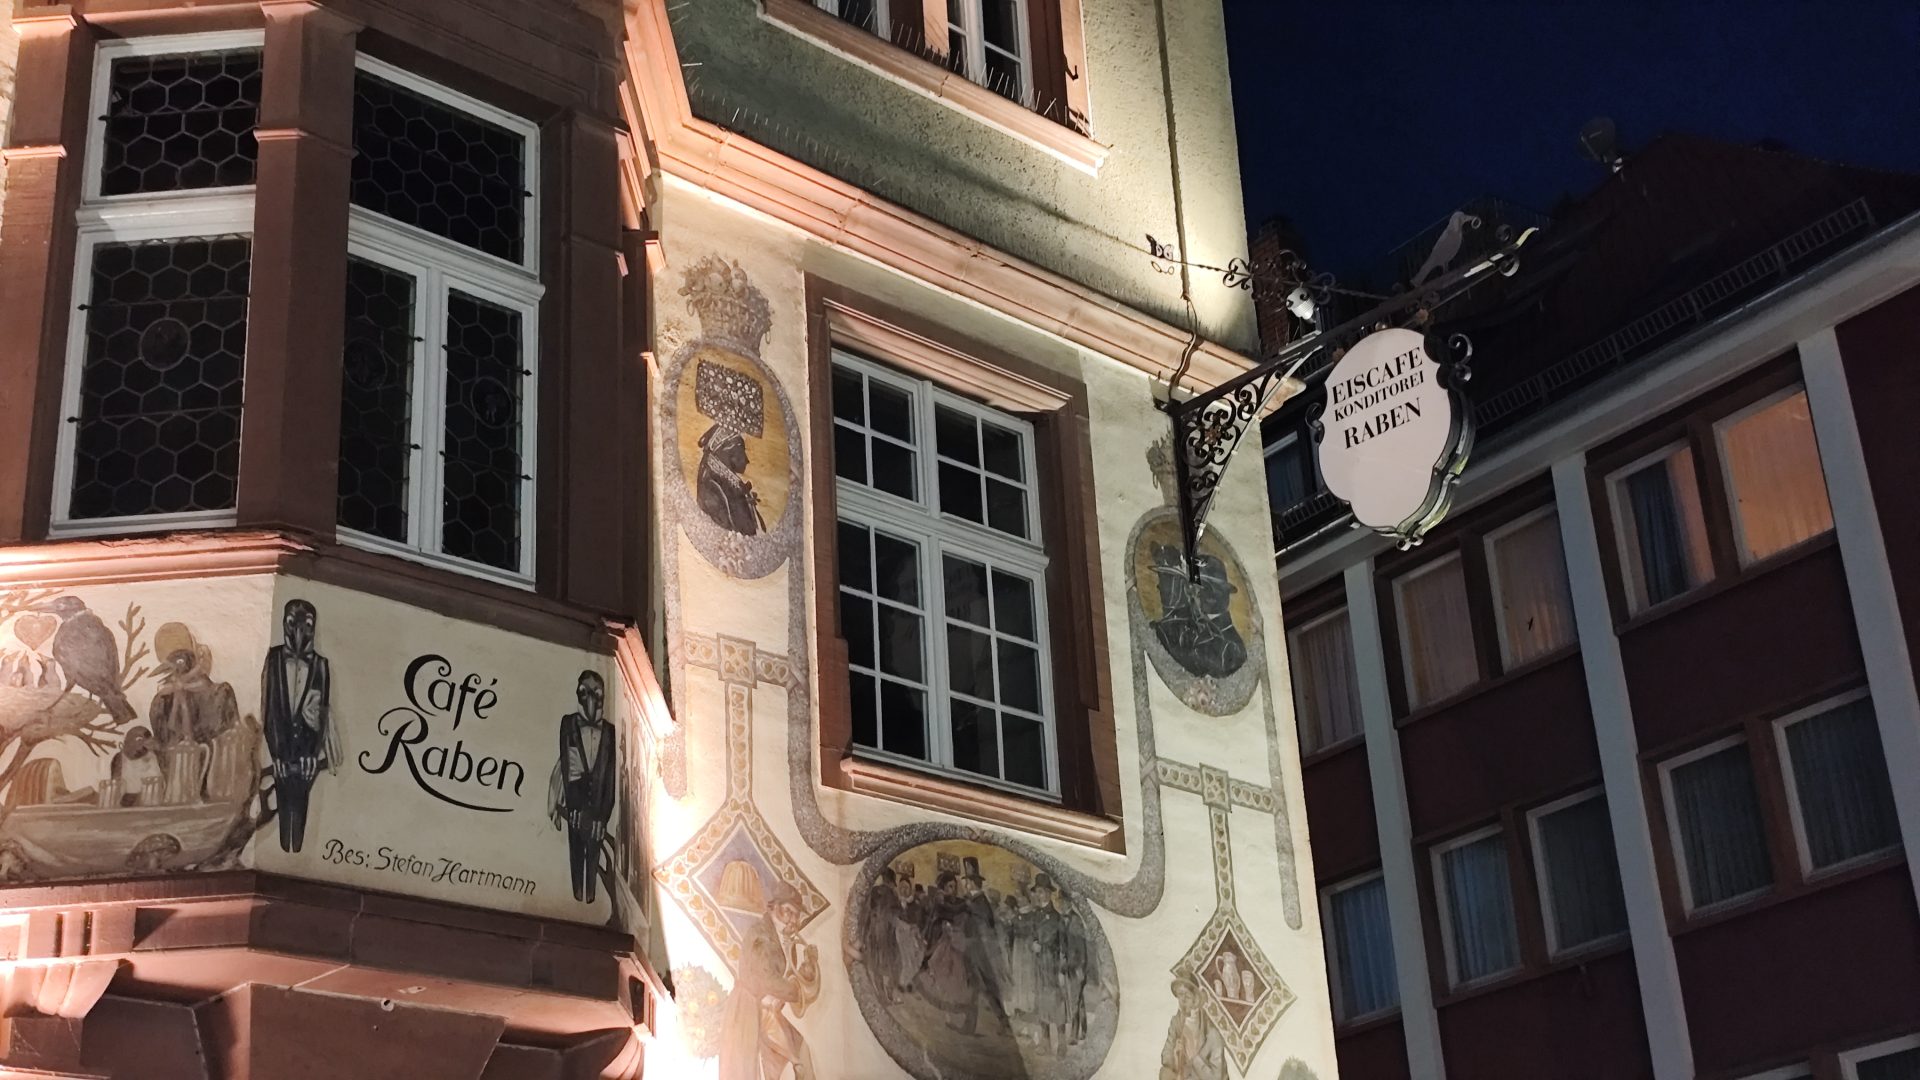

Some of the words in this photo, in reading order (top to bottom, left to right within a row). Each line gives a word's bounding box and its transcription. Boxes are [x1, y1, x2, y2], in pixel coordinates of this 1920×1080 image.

[1332, 346, 1423, 405] EISCAFE
[1334, 370, 1425, 422] KONDITOREI
[1343, 397, 1422, 450] RABEN
[403, 653, 499, 731] Café
[358, 706, 525, 812] Raben
[322, 838, 369, 869] Bes:
[374, 846, 434, 879] Stefan
[431, 857, 537, 896] Hartmann
